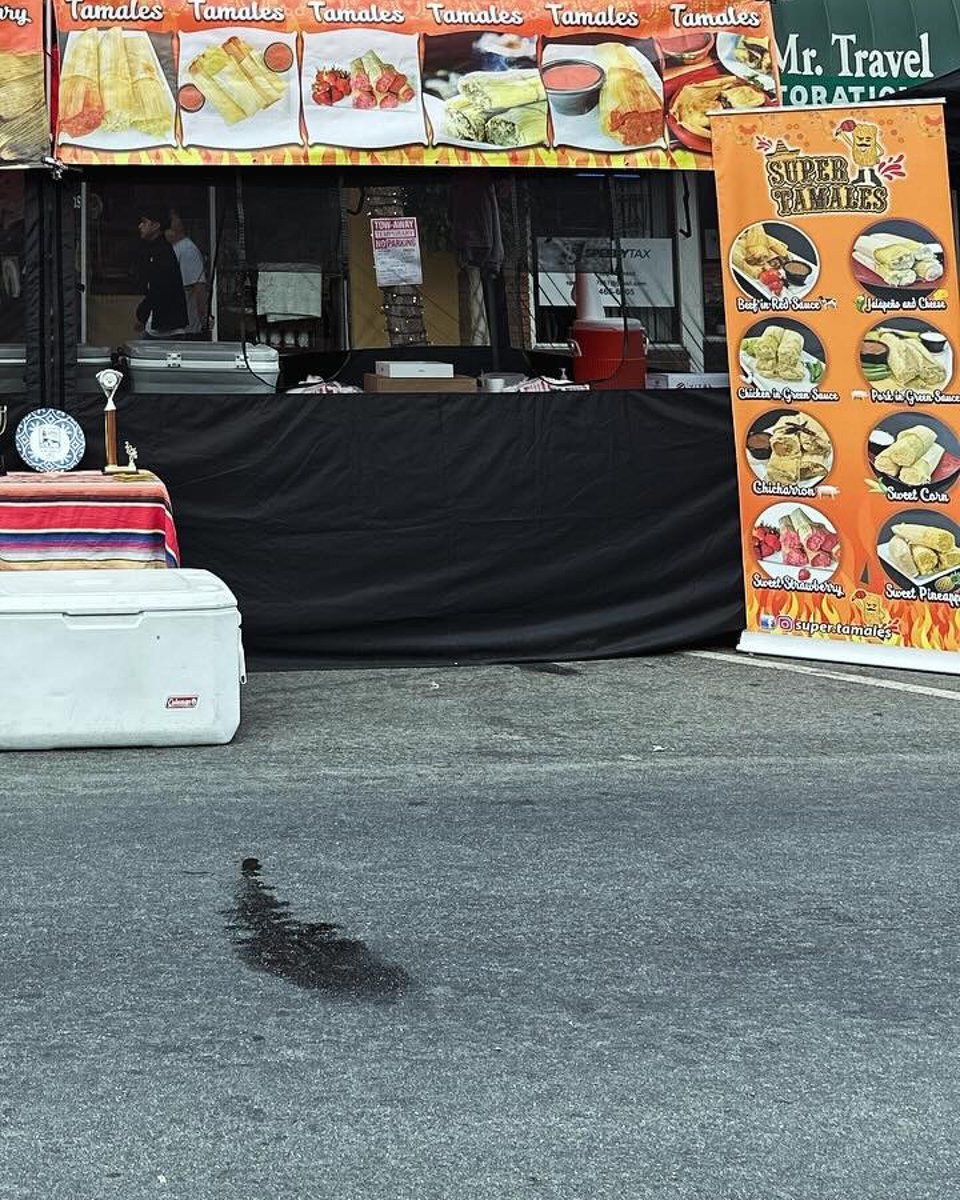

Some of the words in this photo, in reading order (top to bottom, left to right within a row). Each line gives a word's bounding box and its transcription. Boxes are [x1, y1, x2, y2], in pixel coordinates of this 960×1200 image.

[308, 0, 405, 24] Tamales
[426, 2, 524, 26] Tamales
[544, 3, 639, 28] Tamales
[670, 3, 760, 28] Tamales
[777, 33, 823, 76] Mr.
[831, 32, 934, 78] Travel
[781, 84, 907, 106] ORATI
[767, 156, 850, 186] SUPER
[771, 184, 888, 216] TAMALES
[737, 297, 759, 312] Beef
[771, 297, 790, 310] Red
[791, 297, 821, 310] Sauce
[919, 297, 946, 310] Cheese
[737, 387, 770, 399] Chicken
[772, 388, 781, 399] in
[783, 387, 810, 404] Green
[811, 387, 840, 400] Sauce
[871, 388, 893, 402] Pork
[905, 389, 933, 405] Green
[752, 480, 816, 497] Chicharron
[887, 486, 918, 501] Sweet
[920, 488, 950, 502] Corn
[753, 575, 782, 588] Sweet
[783, 576, 845, 597] Strawberry
[886, 584, 917, 599] Sweet
[795, 621, 892, 638] super.tamales
